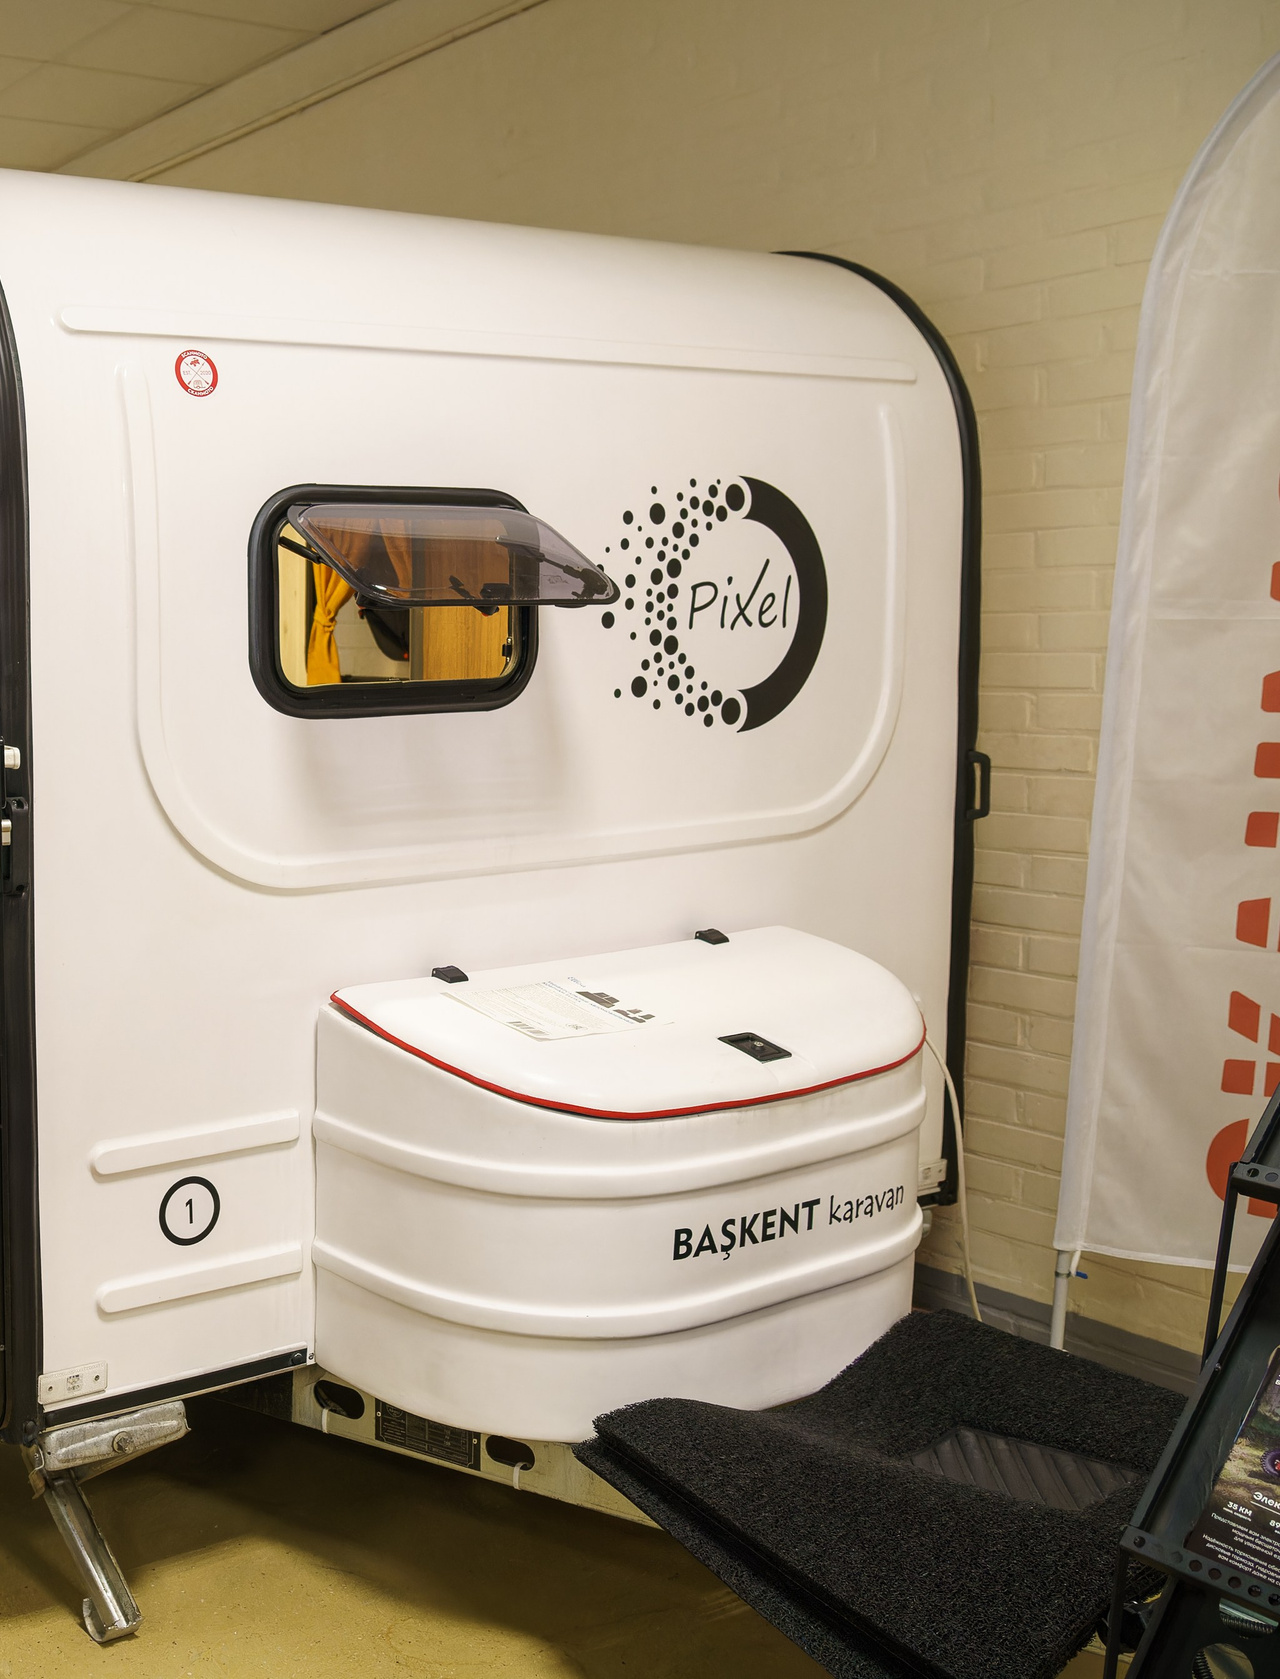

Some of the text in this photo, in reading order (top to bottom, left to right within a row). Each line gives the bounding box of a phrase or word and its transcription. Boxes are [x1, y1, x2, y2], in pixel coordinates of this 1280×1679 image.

[688, 558, 792, 631] Pixel
[184, 1198, 194, 1225] 1
[673, 1185, 904, 1261] BAŞKENT karavan
[1227, 1501, 1239, 1511] 35
[1238, 1505, 1253, 1517] КМ
